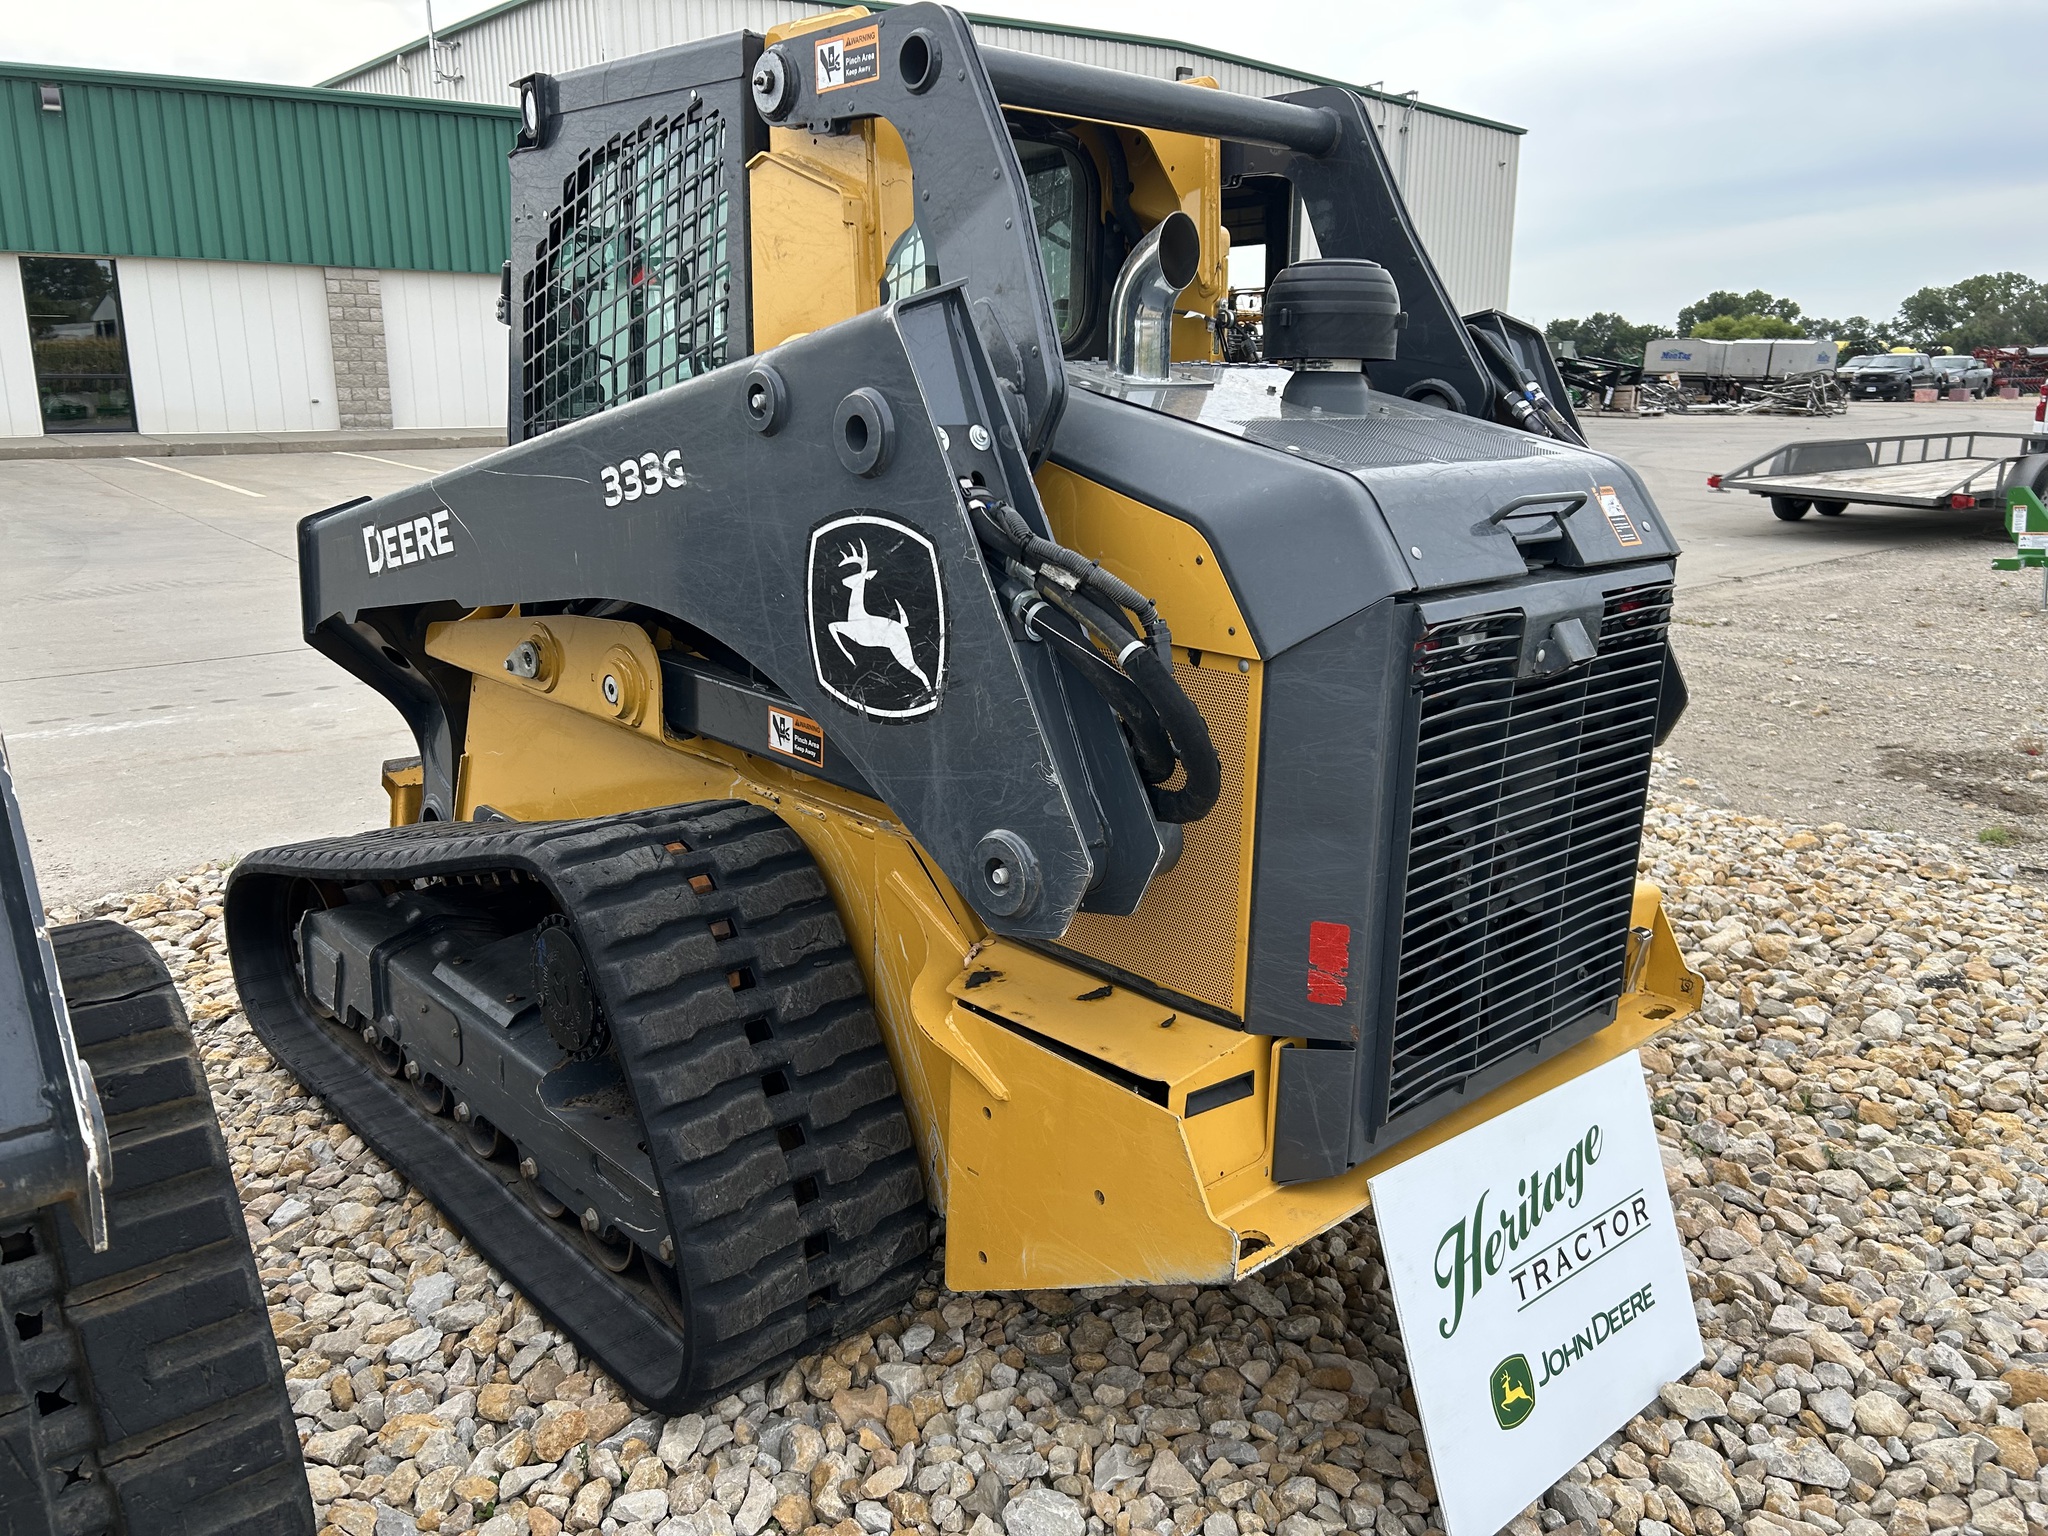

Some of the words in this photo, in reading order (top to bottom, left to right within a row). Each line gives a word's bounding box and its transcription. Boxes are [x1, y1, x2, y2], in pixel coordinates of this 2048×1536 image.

[845, 54, 861, 66] Pinch
[862, 52, 875, 62] Area
[850, 32, 875, 45] WARNING
[600, 450, 687, 507] 333G
[362, 509, 454, 575] DEERE
[794, 734, 807, 745] Pinch
[808, 739, 820, 749] Area
[794, 744, 804, 753] Keep
[805, 748, 816, 757] Away
[1434, 1124, 1603, 1339] Heritage
[1510, 1196, 1650, 1301] TRACTOR
[1538, 1326, 1594, 1388] JOHN
[1591, 1282, 1656, 1346] DEERE
